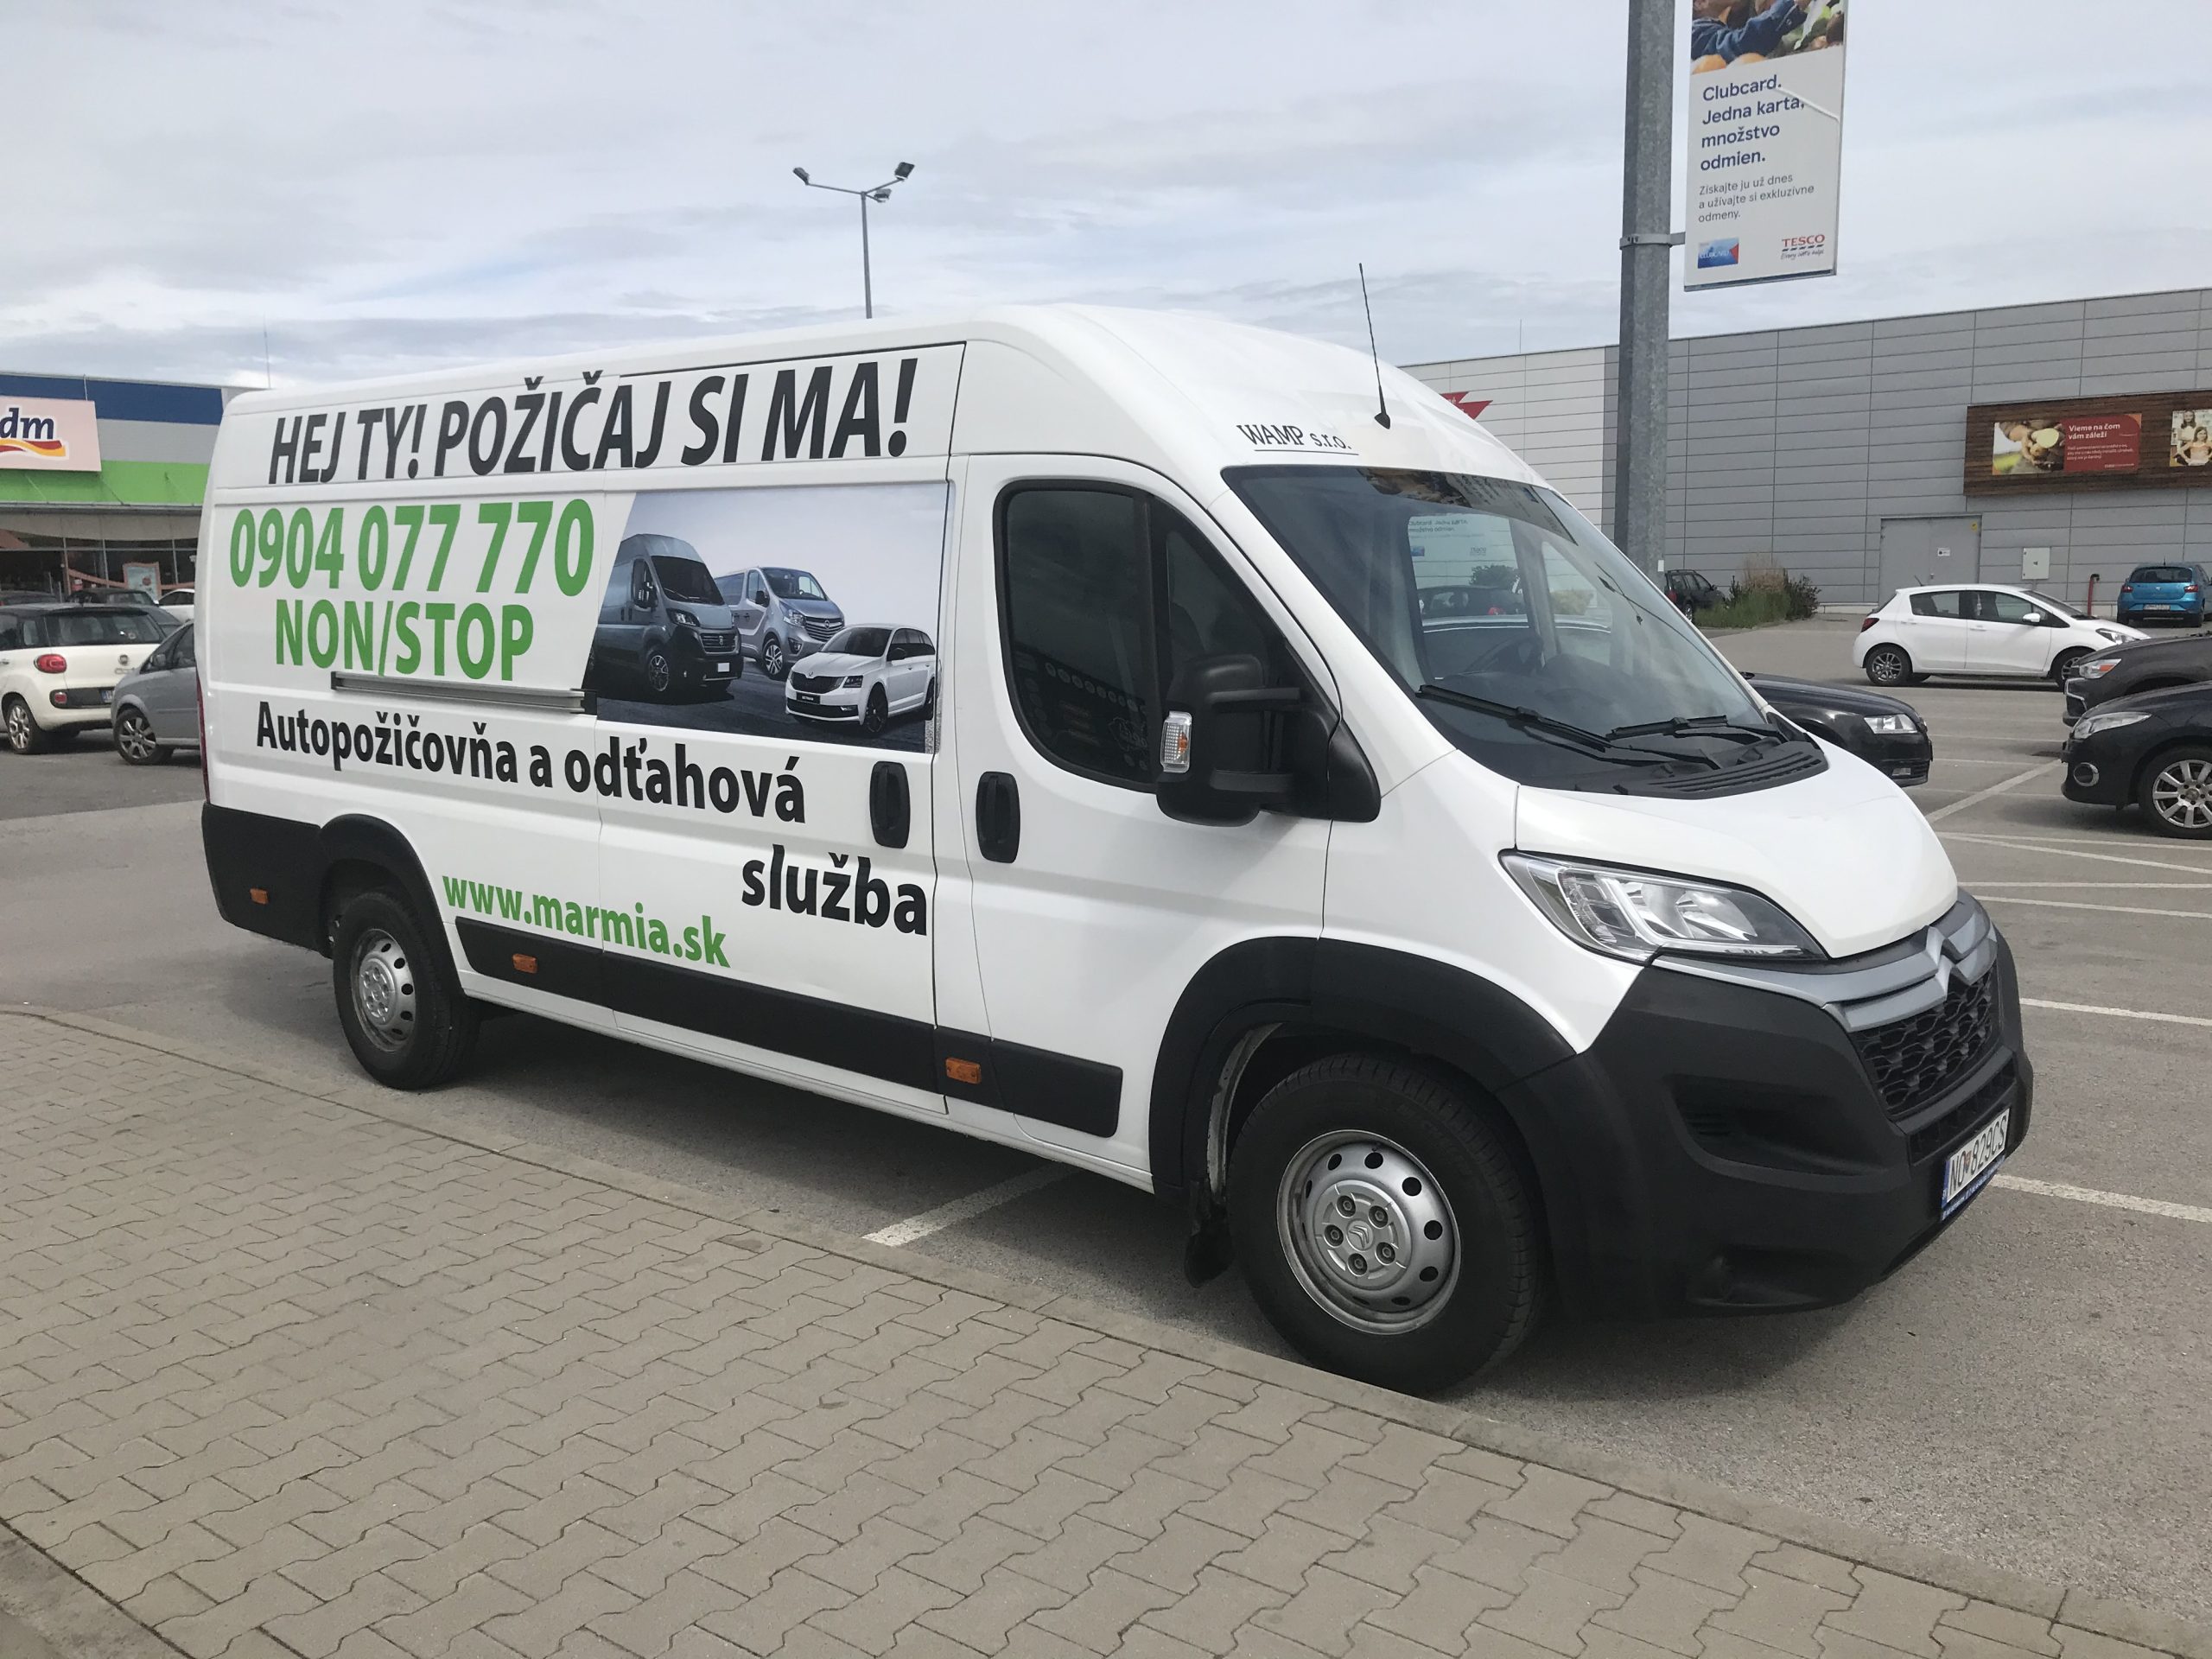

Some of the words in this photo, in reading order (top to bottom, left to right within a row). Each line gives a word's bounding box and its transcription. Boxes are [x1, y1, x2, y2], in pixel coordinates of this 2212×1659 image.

[1702, 74, 1782, 101] Clubcard.
[1701, 105, 1751, 125] Jedna
[1757, 98, 1805, 116] karta,
[1701, 124, 1780, 149] množstvo
[1700, 150, 1765, 171] odmien.
[1699, 181, 1738, 195] Získajte
[1740, 178, 1750, 192] ju
[1752, 175, 1764, 188] už
[1767, 174, 1794, 186] dnes
[1707, 194, 1746, 208] užívajte
[1749, 192, 1757, 203] si
[1759, 185, 1815, 200] exkluzívne
[1698, 209, 1741, 223] odmeny.
[1782, 234, 1826, 248] TESCO
[0, 407, 54, 440] dm
[269, 411, 346, 485] HEJ
[357, 404, 427, 480] TY!
[434, 370, 672, 476] POŽIČAJ
[681, 373, 749, 467] SI
[760, 358, 918, 461] MA!
[1236, 424, 1305, 446] WAMP
[1309, 433, 1352, 449] s.r.o.
[231, 507, 344, 589] 0904
[359, 505, 461, 592] 077
[476, 499, 594, 597] 770
[276, 599, 534, 682] NON/STOP
[257, 700, 518, 783] Autopožičovňa
[529, 754, 553, 788] a
[564, 734, 807, 823] odťahová
[741, 843, 928, 936] služba
[442, 876, 731, 969] www.marmia.sk
